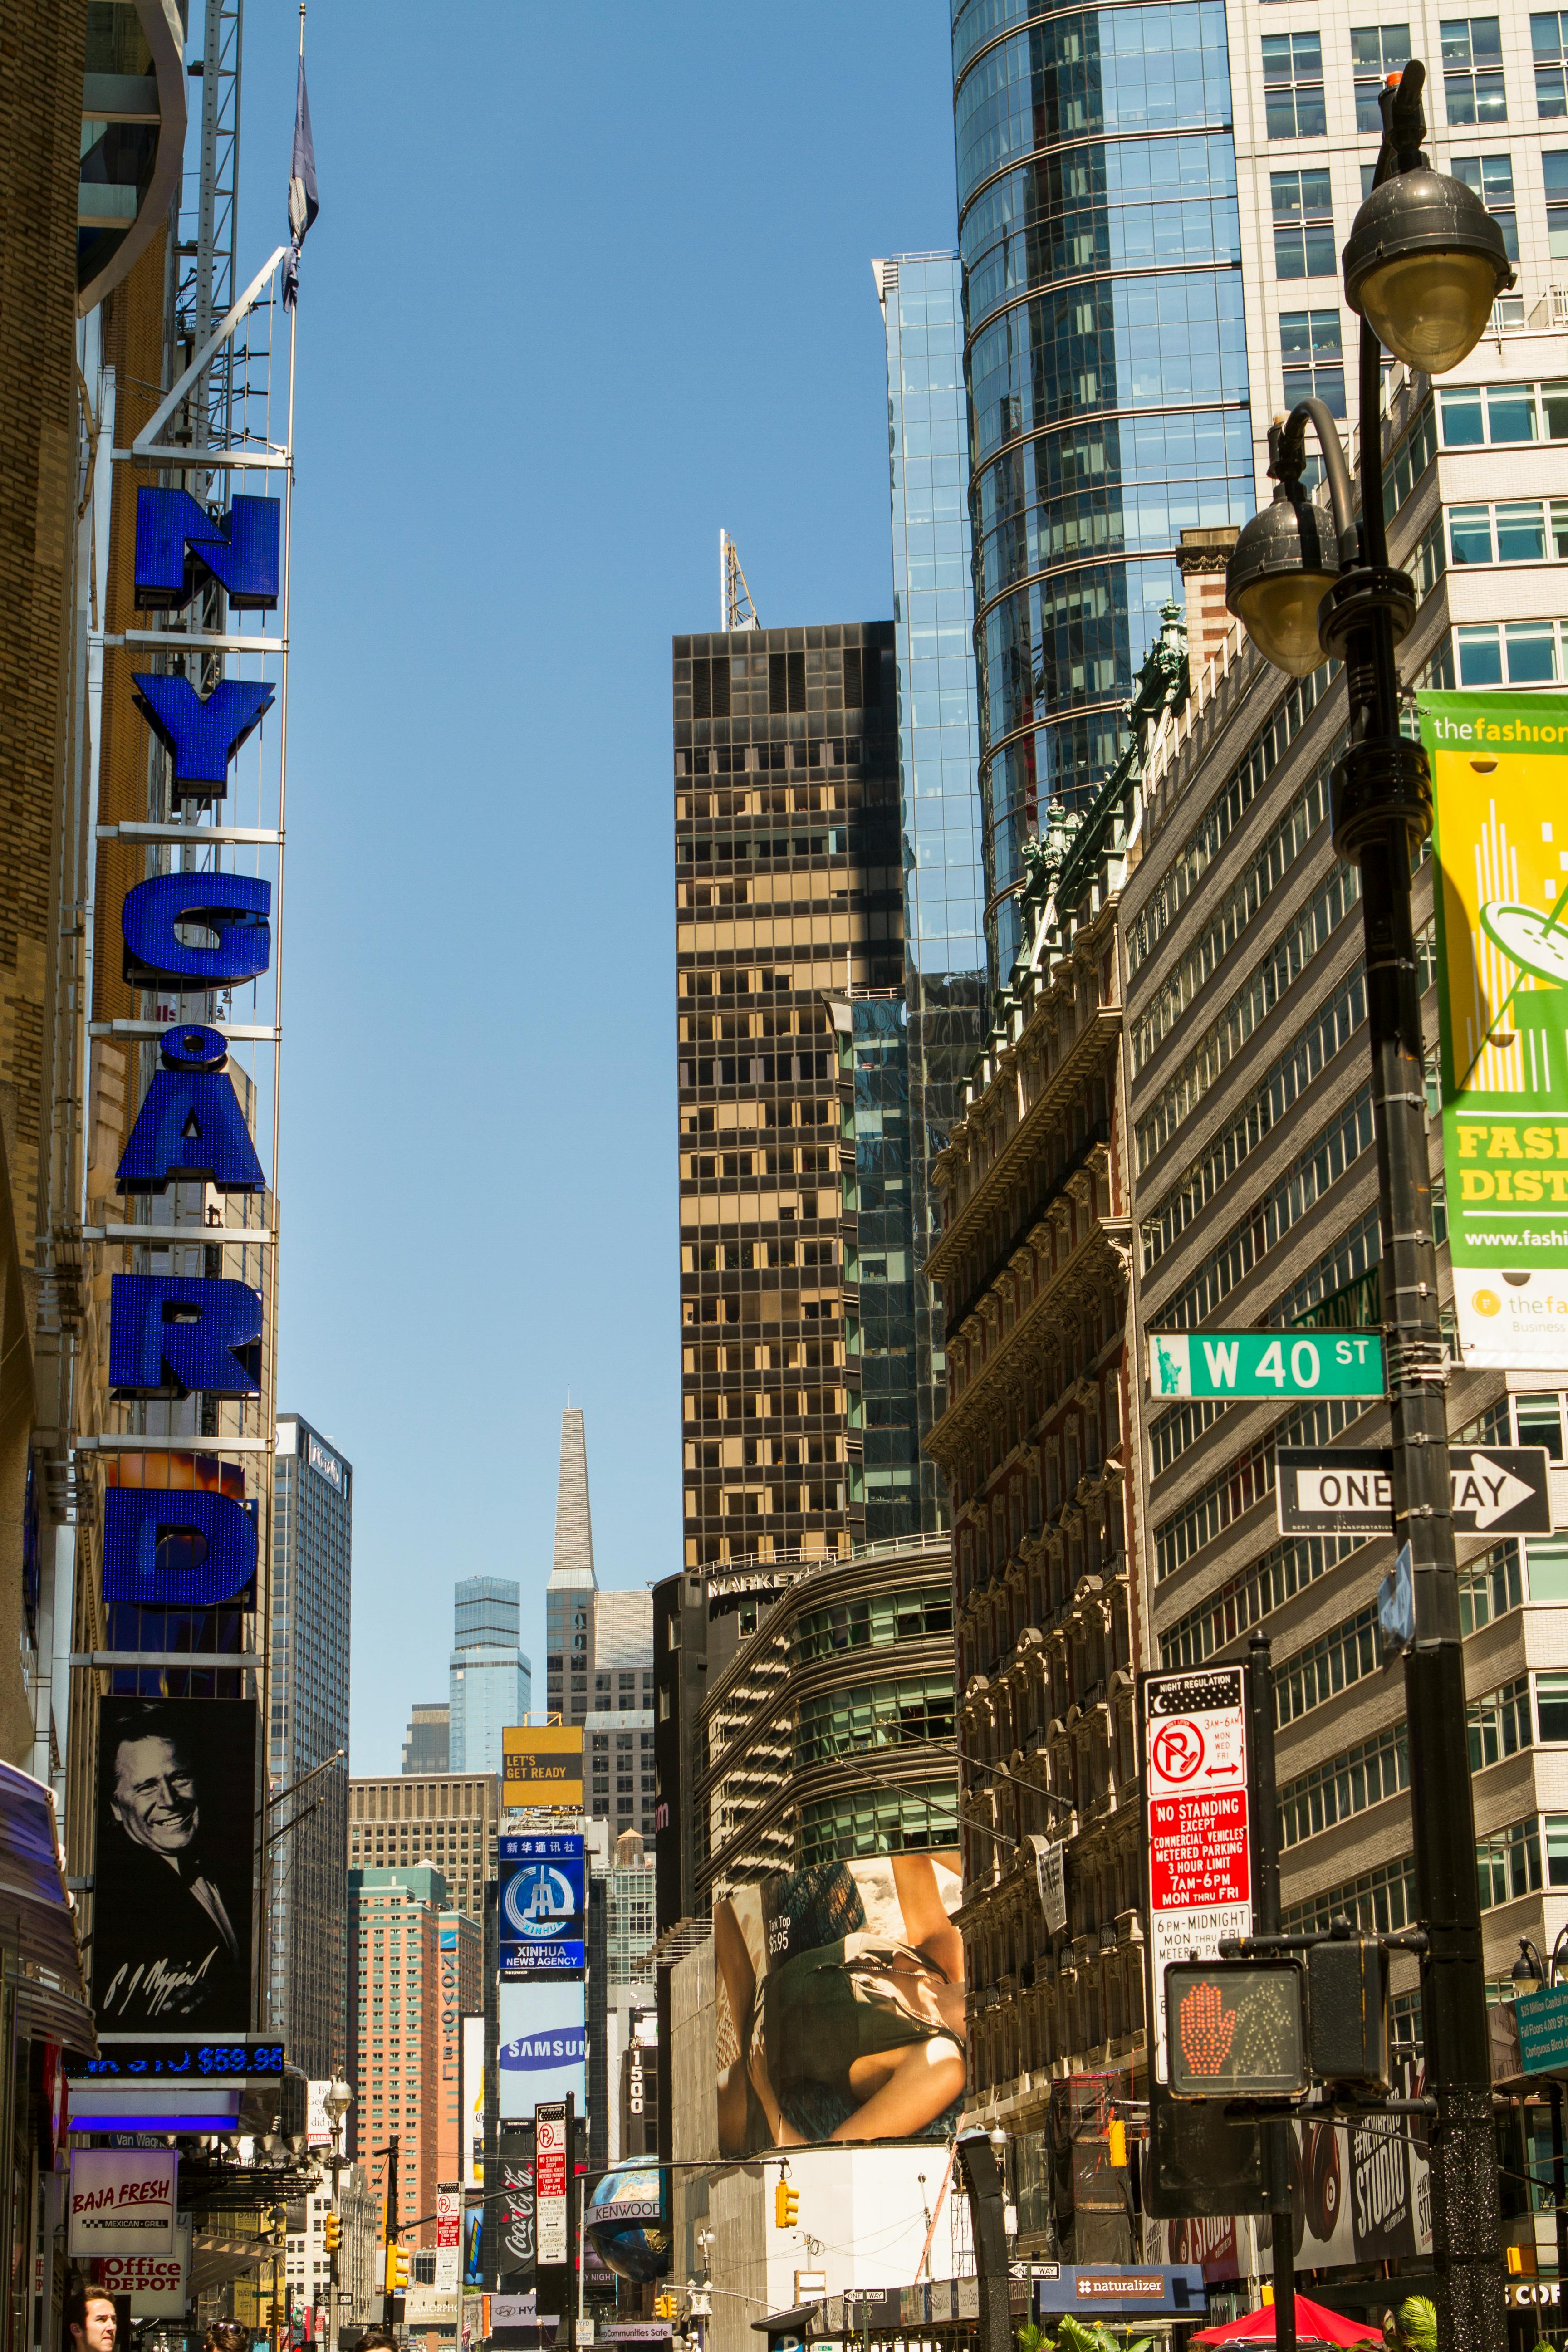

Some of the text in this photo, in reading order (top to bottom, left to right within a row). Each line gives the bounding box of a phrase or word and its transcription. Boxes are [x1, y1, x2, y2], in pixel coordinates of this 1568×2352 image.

[1513, 1321, 1566, 1333] Business
[1203, 1340, 1369, 1388] W 40 ST
[1319, 1475, 1507, 1507] ONE AY
[1160, 1675, 1231, 1693] NIGHT REGULATION
[1215, 1732, 1230, 1740] MON
[1215, 1742, 1230, 1750] WED
[507, 1755, 536, 1766] LET'S
[507, 1767, 566, 1779] GET READY
[1157, 1798, 1239, 1822] NO STANDING
[1181, 1818, 1215, 1833] EXCEPT
[1154, 1828, 1244, 1849] COMMERCIAL VEHICLES
[507, 1842, 575, 1853] 新华通讯社
[1156, 1842, 1243, 1862] METERED PARKING
[1168, 1857, 1230, 1874] 3 HOUR LIMIT
[1162, 1886, 1239, 1905] MON THRU FRI
[523, 1921, 563, 1935] XINHUA
[769, 1916, 791, 1932] Tank Top
[769, 1931, 789, 1956] $5.95
[1164, 1933, 1191, 1945] MON
[1196, 1934, 1217, 1943] THRU
[517, 1946, 566, 1957] XINHUA
[506, 1957, 578, 1966] NEWS AGENCY
[1530, 2002, 1545, 2014] Million
[1545, 1993, 1562, 2010] Capital
[441, 1954, 455, 2080] NOVOTEL
[1529, 2024, 1544, 2036] Floors
[1544, 2018, 1557, 2033] 4,000
[1557, 2015, 1563, 2028] SF
[1525, 2037, 1564, 2058] Contiguous Block
[198, 2048, 282, 2074] $59.95
[631, 2051, 643, 2114] 1500
[311, 2117, 325, 2126] did
[116, 2135, 134, 2146] Van
[1356, 2132, 1404, 2239] STUDIO
[73, 2180, 170, 2214] BAJA FRESH
[105, 2258, 181, 2276] Office
[106, 2278, 180, 2291] DEPOT
[1093, 2280, 1161, 2292] naturalizer
[607, 2329, 649, 2337] Communities
